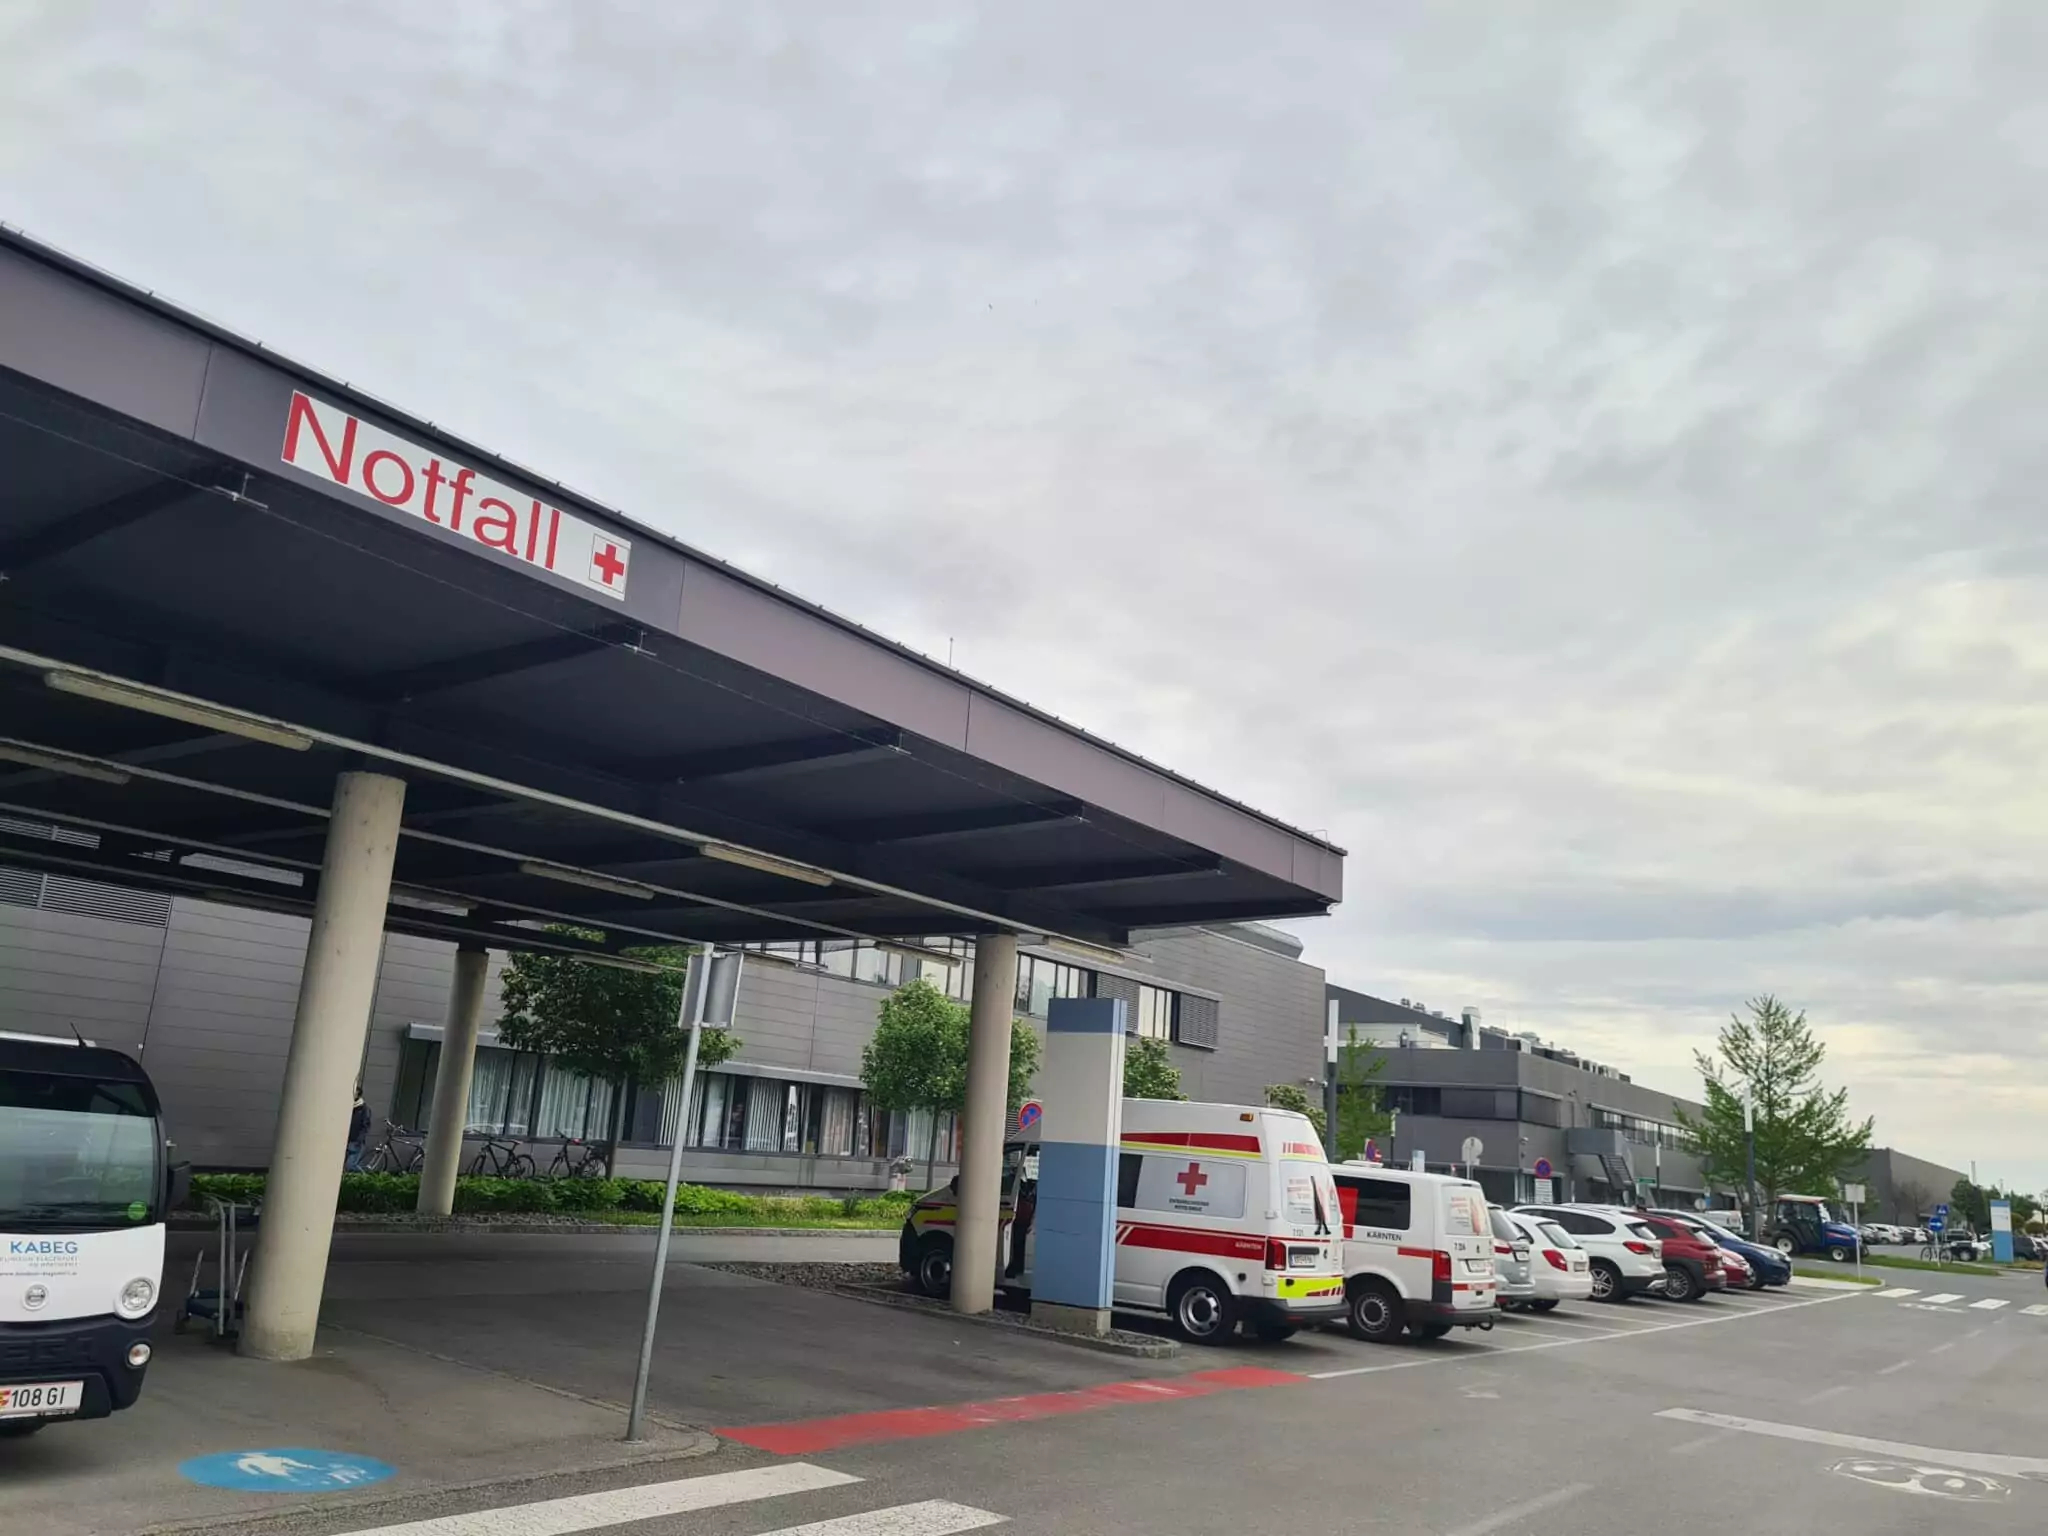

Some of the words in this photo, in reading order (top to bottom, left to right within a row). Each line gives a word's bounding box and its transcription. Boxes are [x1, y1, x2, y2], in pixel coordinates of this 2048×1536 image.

[281, 391, 561, 570] Notfall
[10, 1241, 78, 1254] KABEG
[12, 1388, 42, 1408] 108
[47, 1387, 65, 1405] GI
